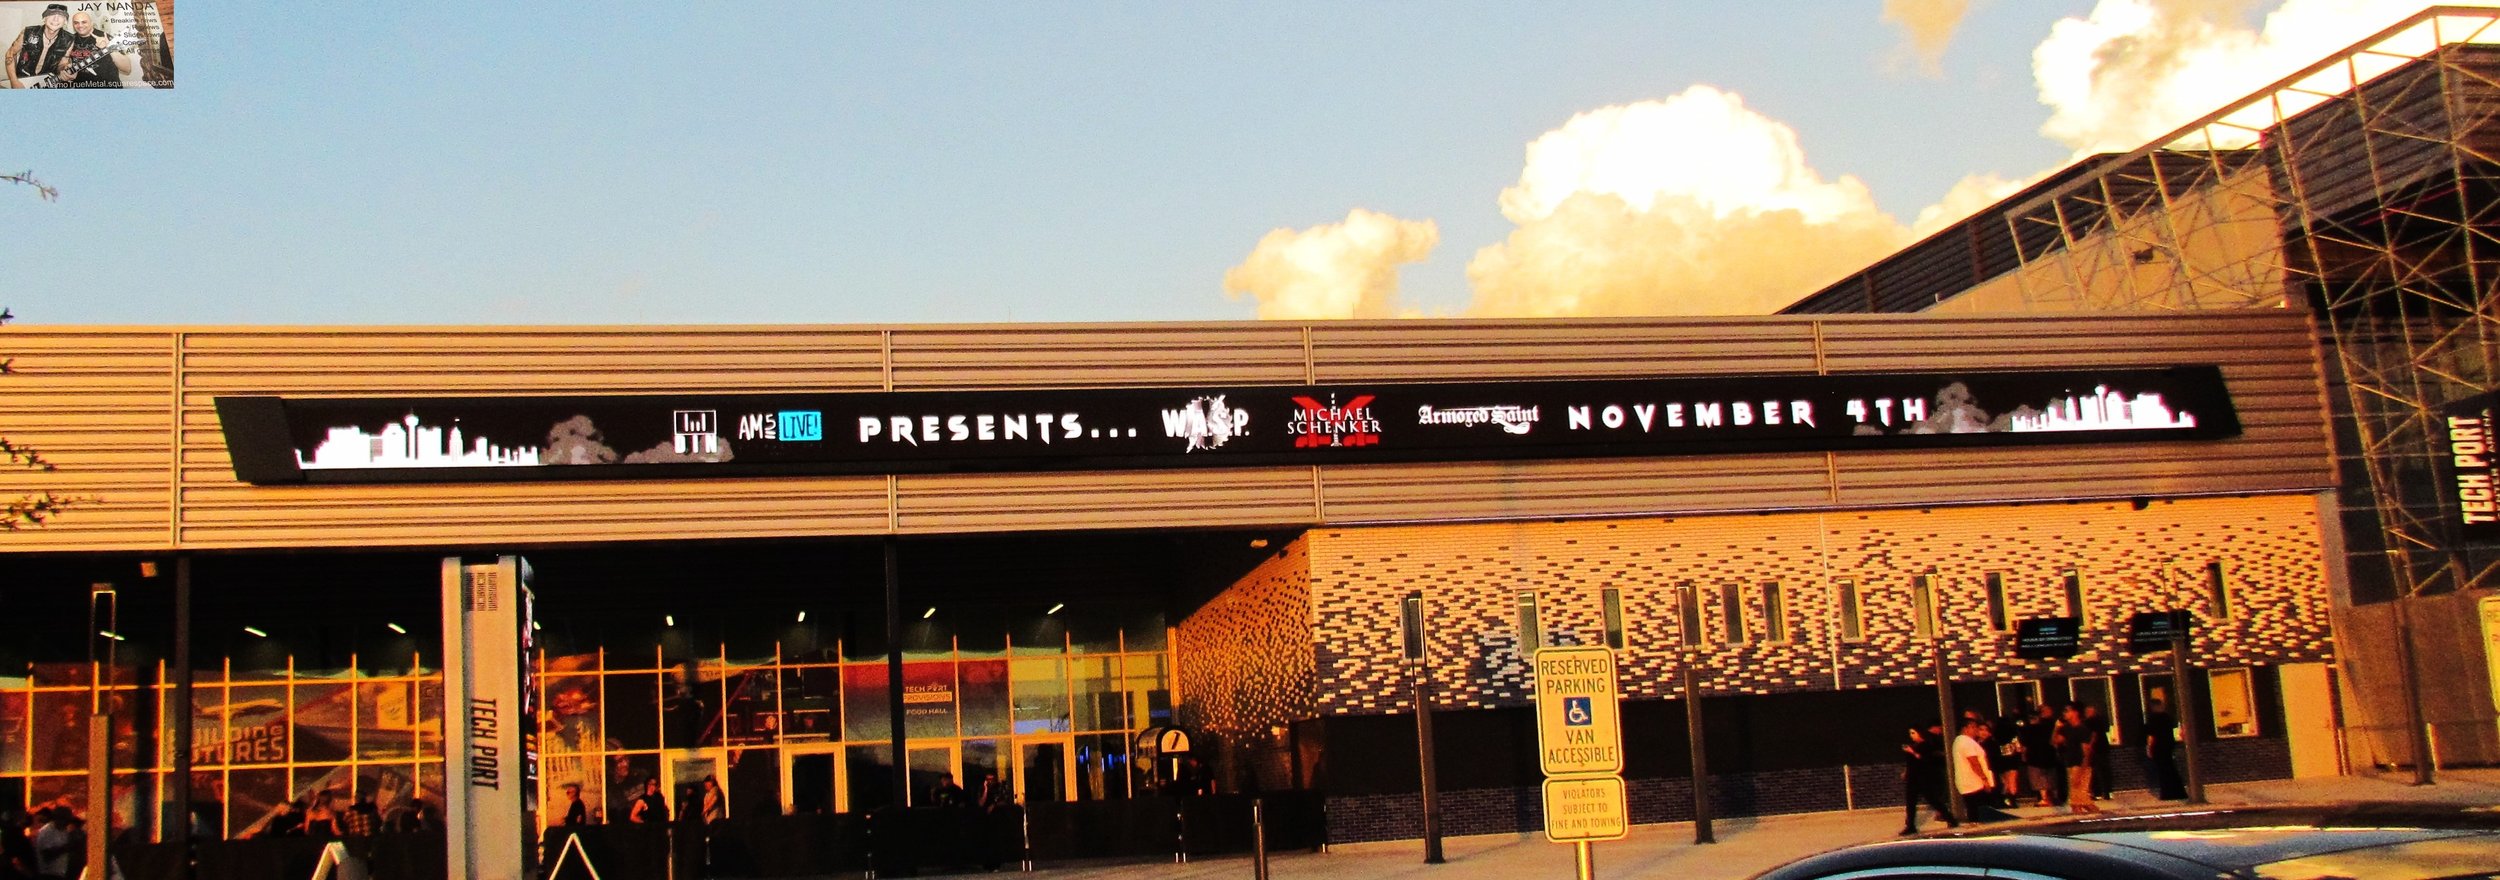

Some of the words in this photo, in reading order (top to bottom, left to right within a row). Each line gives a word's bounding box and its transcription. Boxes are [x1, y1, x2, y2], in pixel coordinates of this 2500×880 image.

[1294, 407, 1374, 421] MICHAEL
[1418, 405, 1489, 427] Armored
[1490, 404, 1541, 433] Saint
[1568, 399, 1815, 432] NOVEMBER
[1846, 397, 1928, 427] 4TH
[783, 413, 818, 439] LIVE!
[1287, 420, 1382, 434] SCHENKER
[2447, 416, 2490, 468] PORT
[2456, 474, 2498, 525] TECH
[1541, 658, 1608, 676] RESERVED
[1546, 676, 1605, 694] PARKING
[471, 698, 498, 740] TECH
[1565, 729, 1595, 745] VAN
[1548, 746, 1615, 764] ACCESSIBLE
[471, 744, 499, 791] PORT
[1562, 787, 1606, 800] VIOLATORS
[1563, 803, 1595, 815] SUBJECT
[1598, 802, 1608, 812] TO
[1551, 819, 1568, 830] FINE
[1573, 818, 1588, 829] AND
[1590, 816, 1621, 828] TOWING
